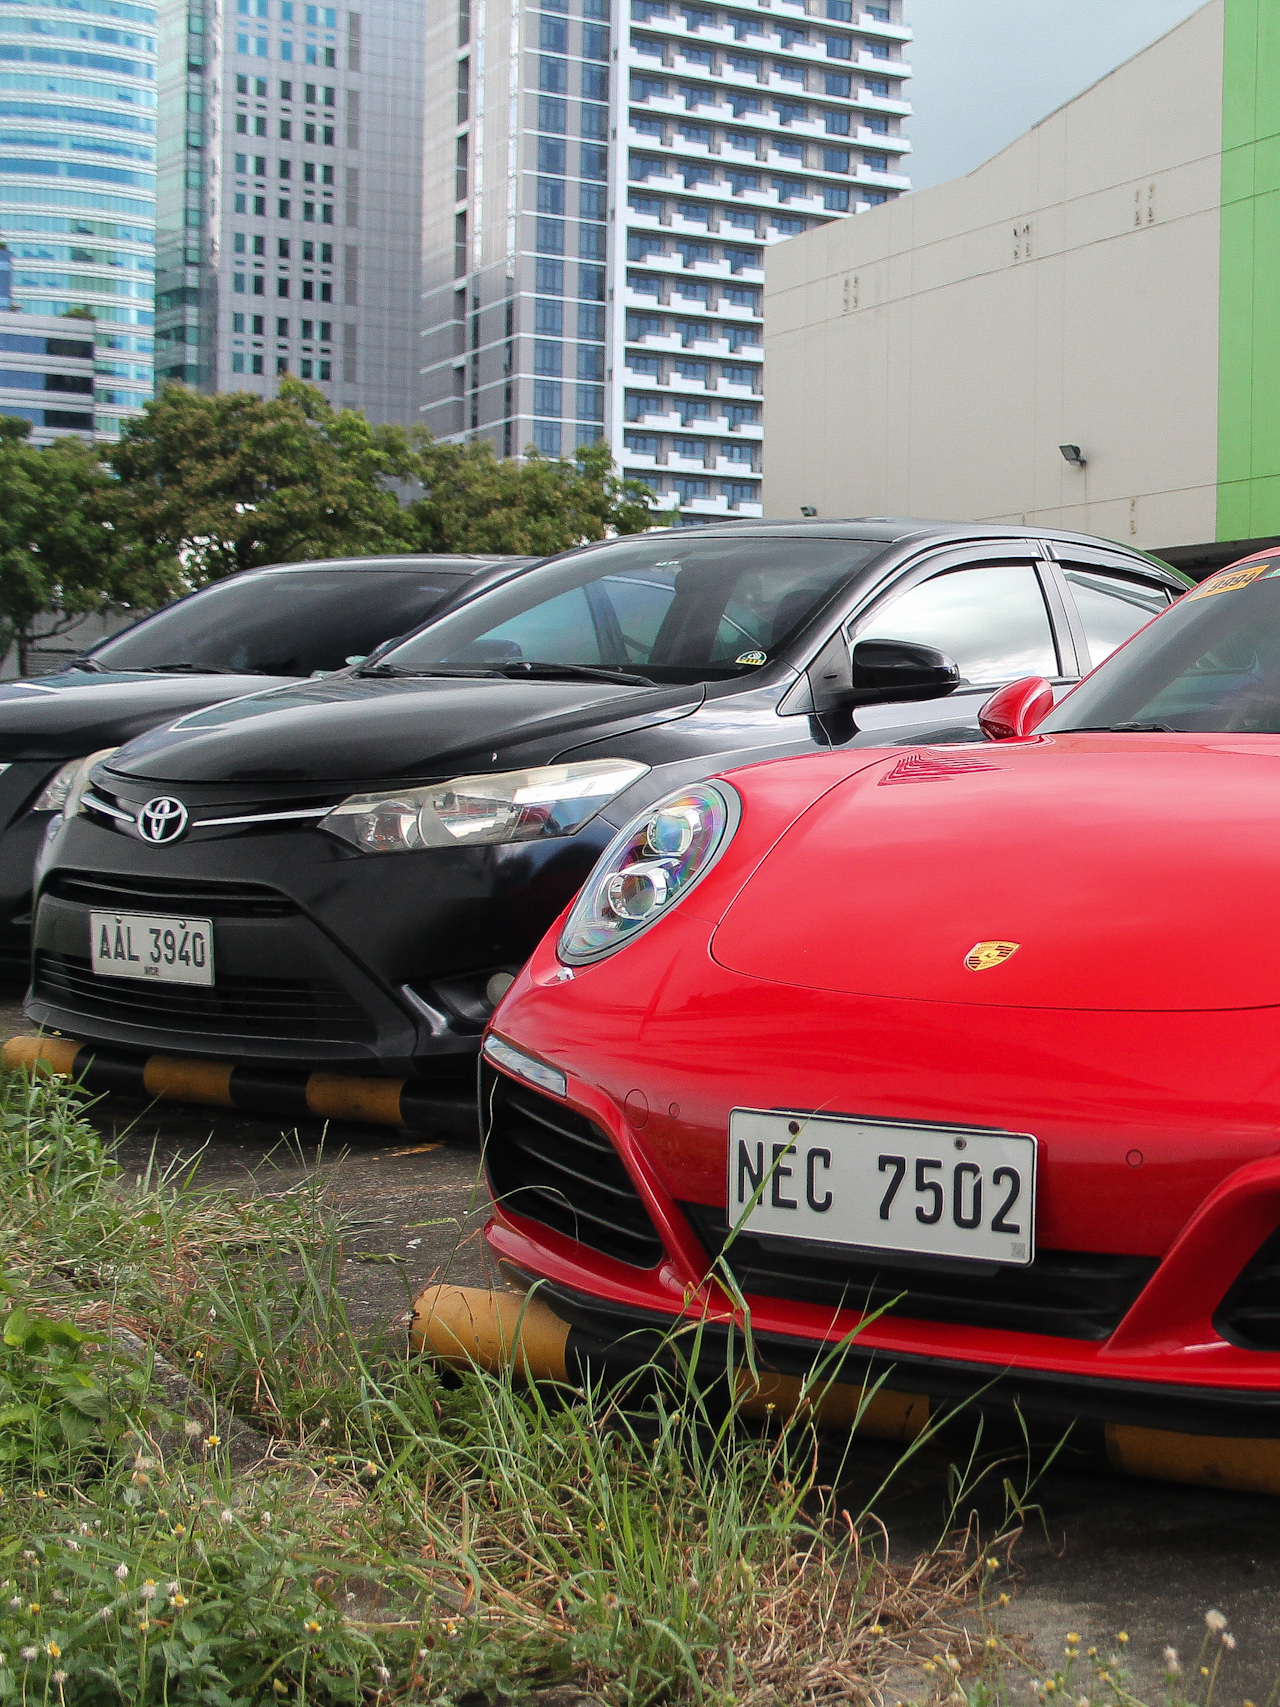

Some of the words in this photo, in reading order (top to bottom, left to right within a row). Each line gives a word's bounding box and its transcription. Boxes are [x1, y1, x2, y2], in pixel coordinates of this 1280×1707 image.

[99, 923, 140, 961] AAL
[149, 927, 206, 967] 3940
[737, 1139, 833, 1213] NEC
[878, 1154, 1021, 1234] 7502
